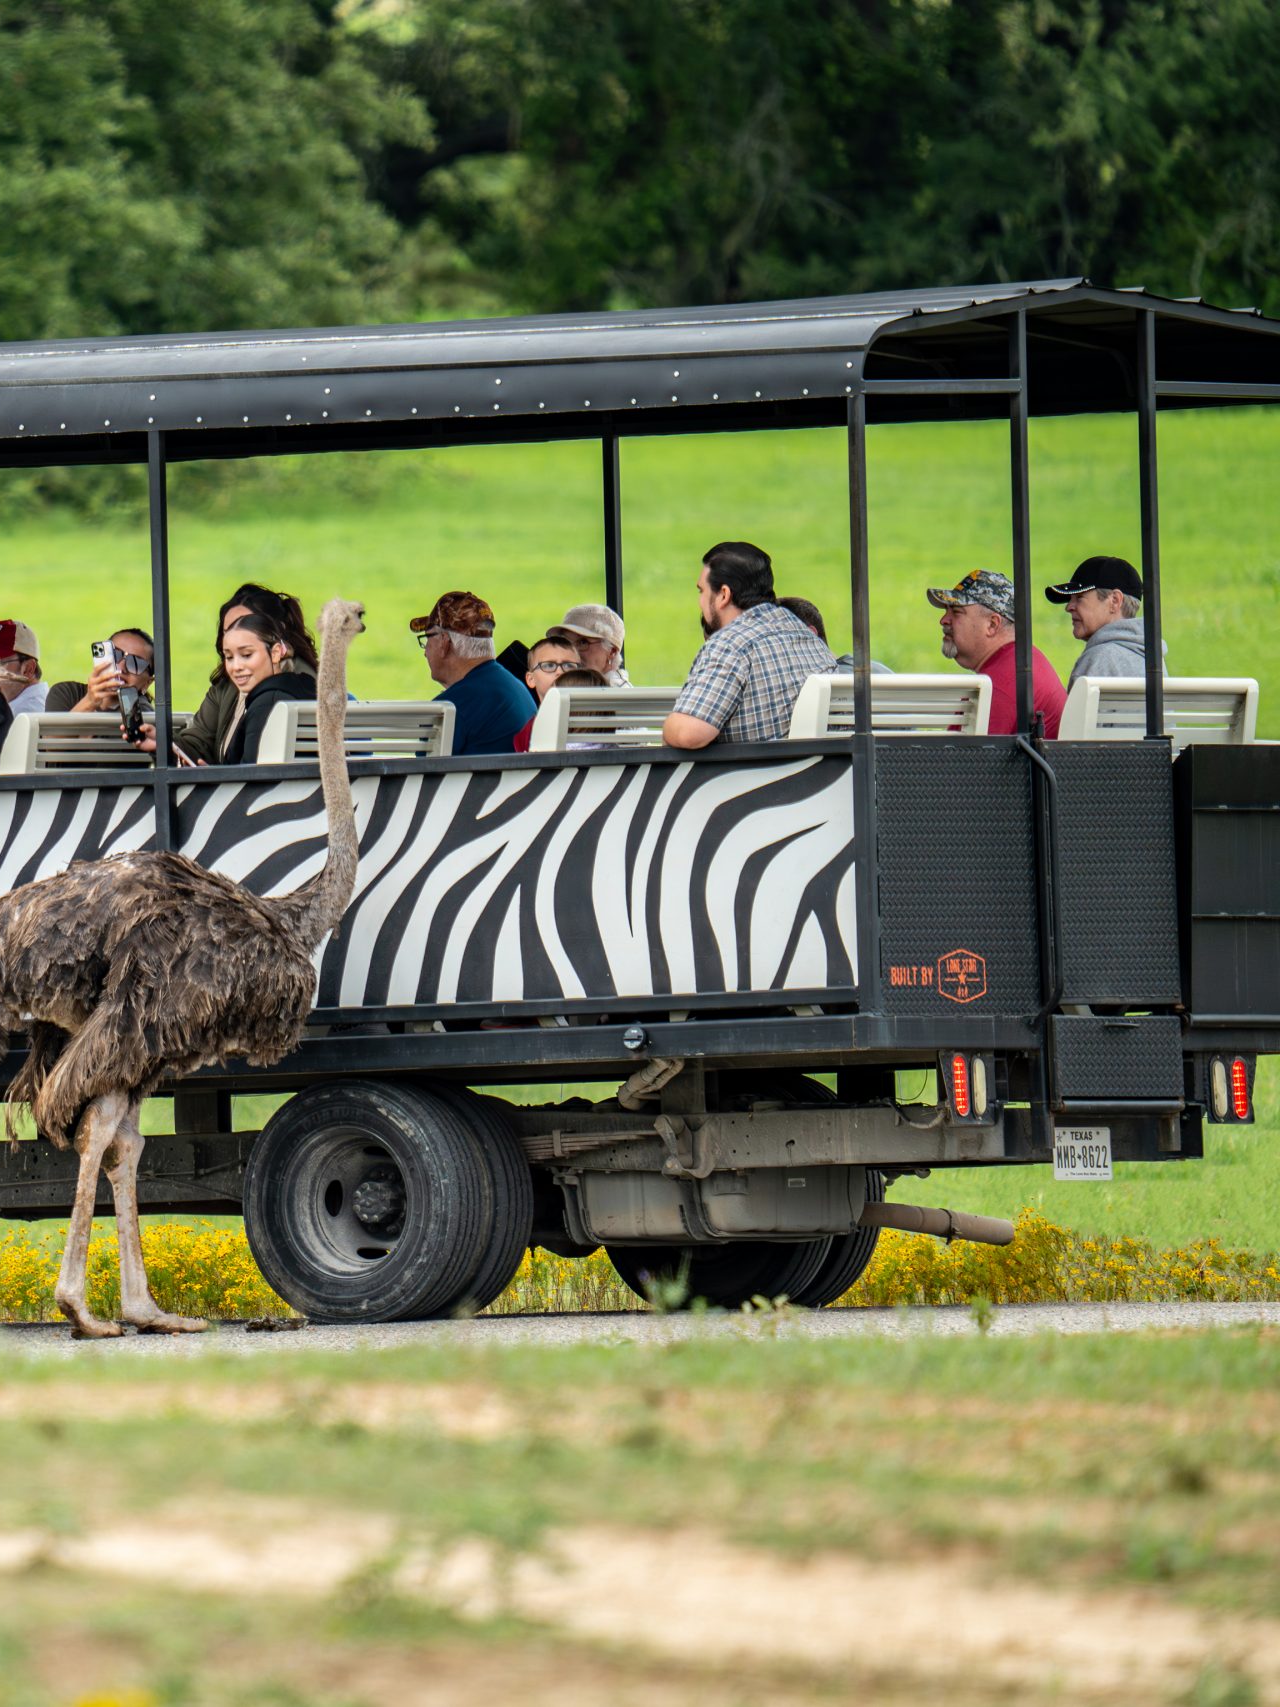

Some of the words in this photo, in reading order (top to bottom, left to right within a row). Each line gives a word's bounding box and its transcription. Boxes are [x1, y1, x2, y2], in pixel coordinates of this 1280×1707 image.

[890, 966, 918, 986] BUILT
[921, 966, 934, 986] BY
[1070, 1131, 1093, 1141] TEXAS
